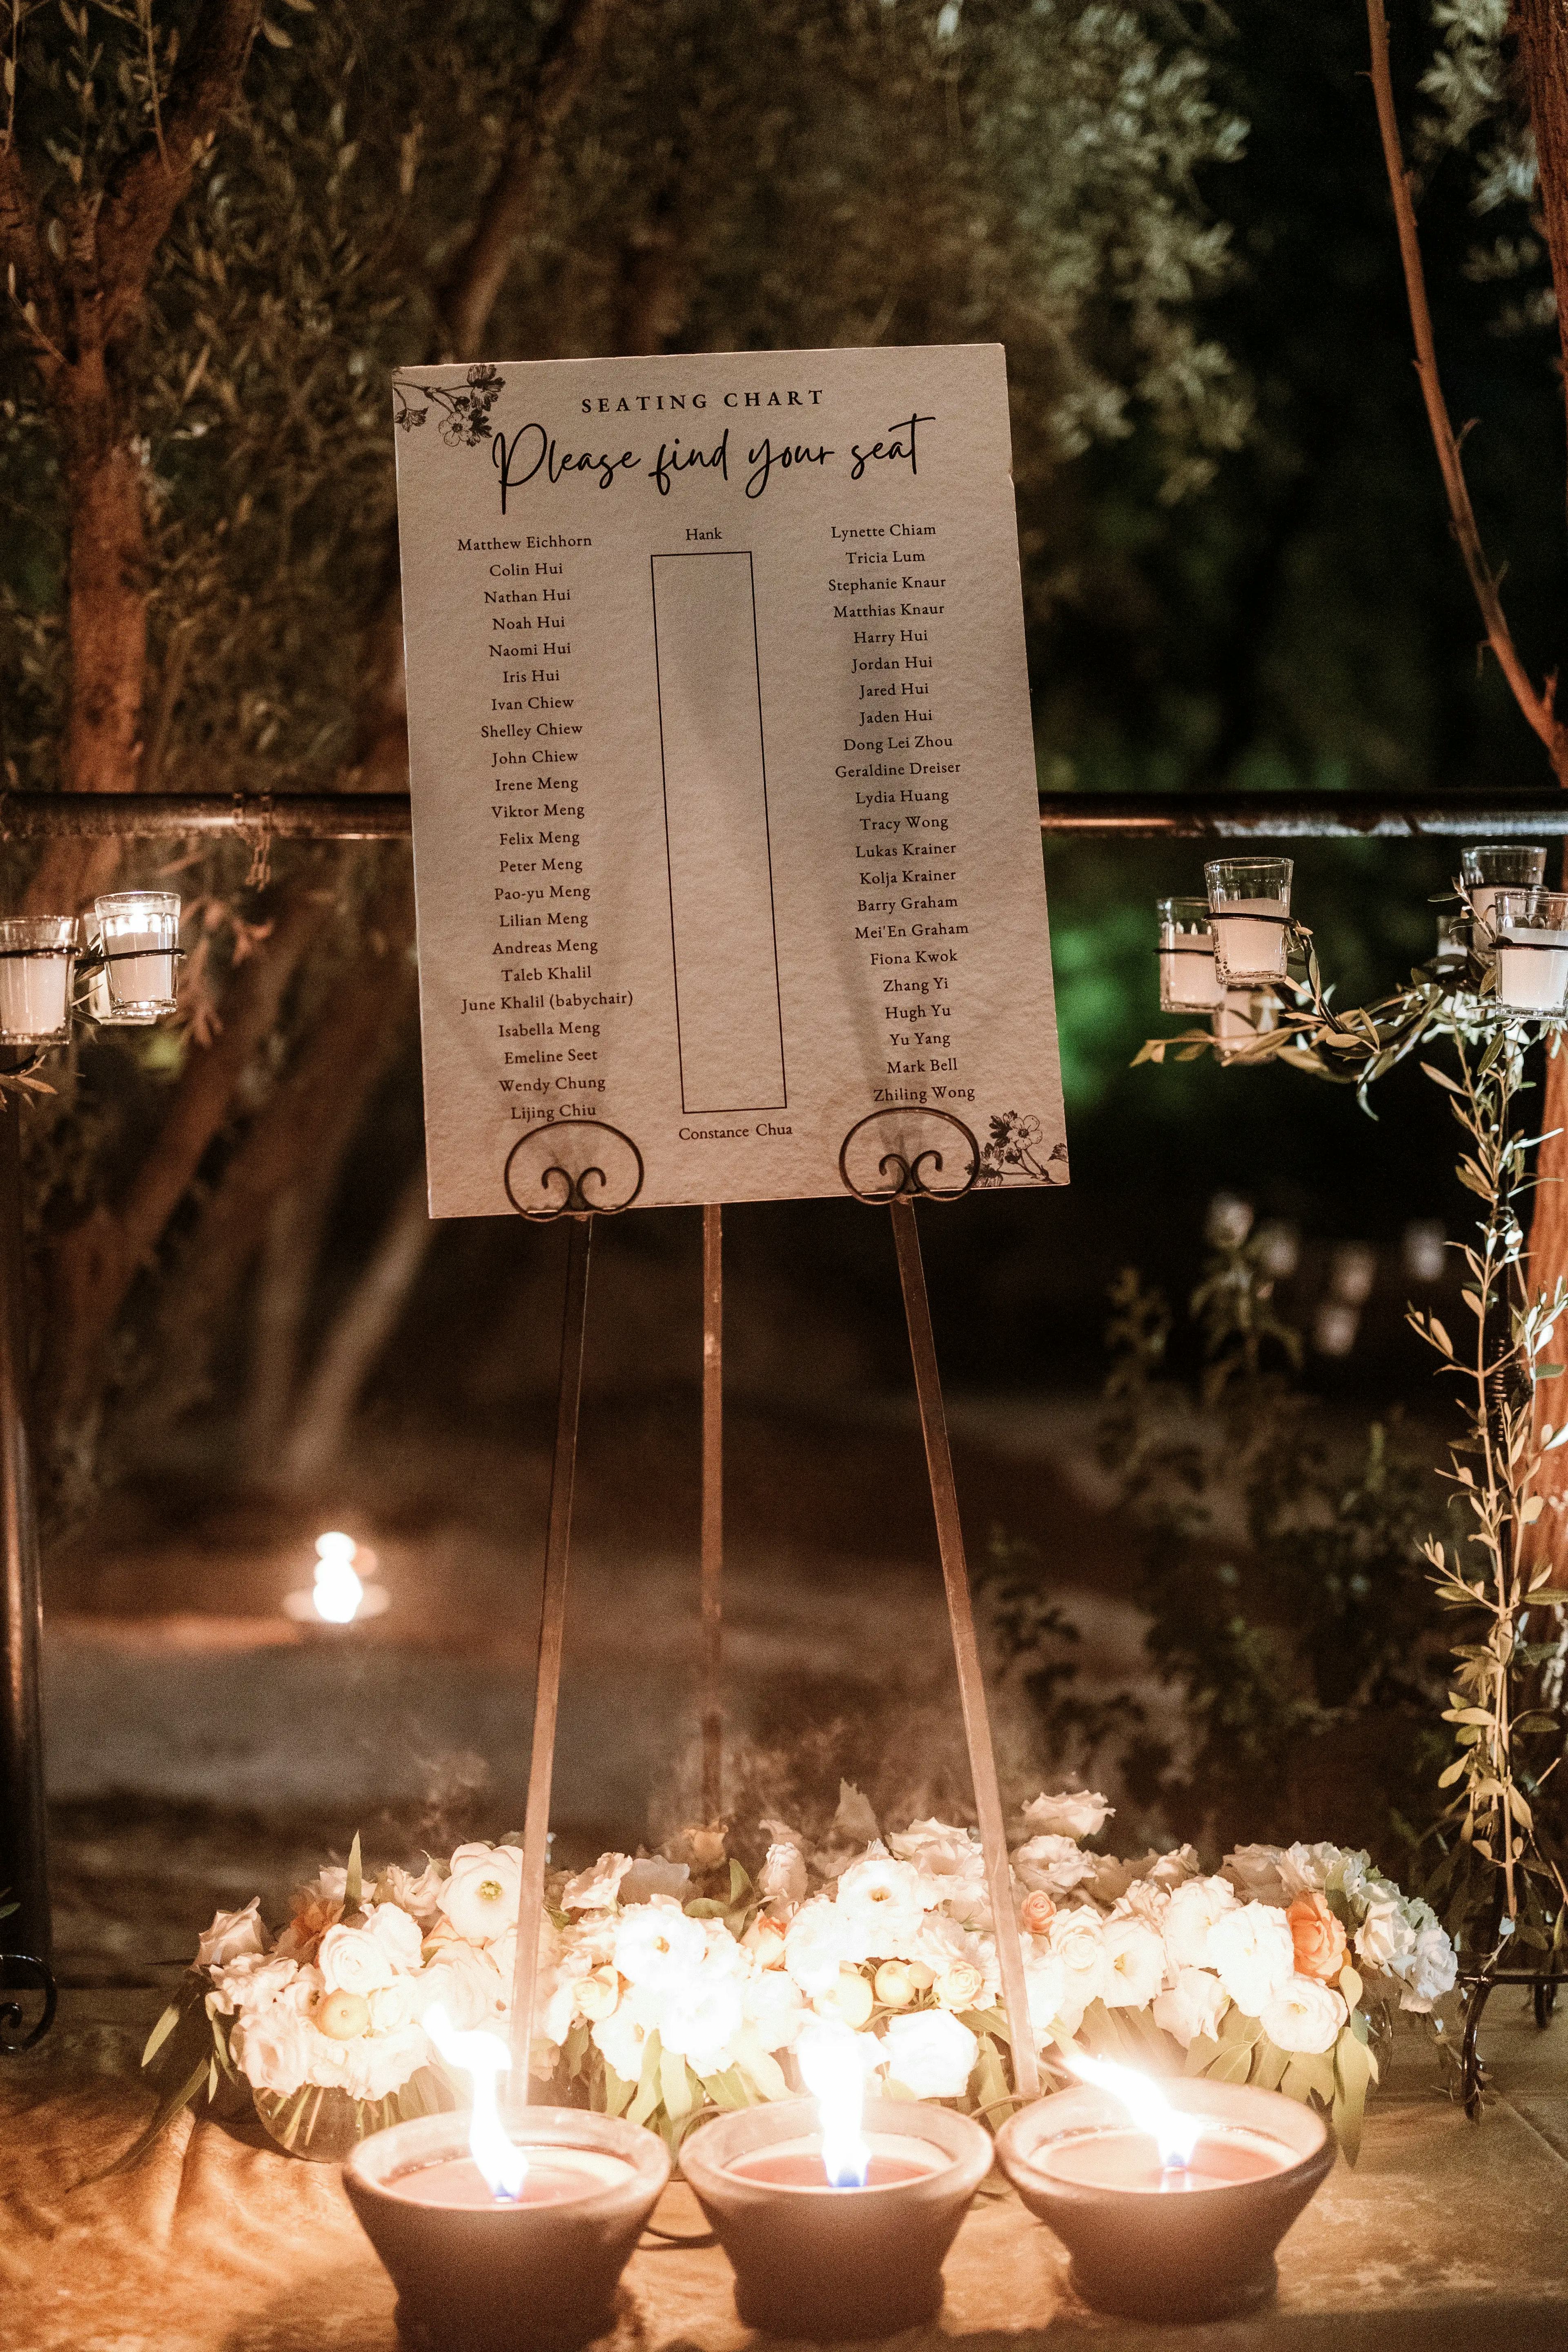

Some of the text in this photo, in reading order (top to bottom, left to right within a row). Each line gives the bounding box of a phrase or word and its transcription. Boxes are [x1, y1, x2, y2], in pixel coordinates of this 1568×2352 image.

[581, 390, 822, 413] SEATING CHART
[492, 413, 936, 515] Please find your seat
[686, 527, 722, 541] Hank
[831, 523, 936, 542] Lynette Chiam
[458, 535, 592, 551] Matthew Eichhorn
[845, 550, 925, 564] Tricia Lum
[489, 563, 563, 576] Colin Hui
[829, 576, 946, 595] Stephanie Knaur
[484, 589, 570, 604] Nathan Hui
[834, 603, 944, 618] Matthias Knaur
[492, 616, 565, 630] Noah Hui
[854, 630, 928, 646] Harry Hui
[489, 642, 570, 657] Naomi Hui
[851, 656, 932, 674] Jordan Hui
[503, 670, 559, 683] Iris Hui
[859, 683, 929, 700] Jared Hui
[492, 696, 574, 711] Ivan Chiew
[859, 710, 932, 727] Jaden Hui
[481, 722, 582, 740] Shelley Chiew
[844, 735, 953, 754] Dong Lei Zhou
[491, 750, 578, 768] John Chiew
[835, 762, 960, 778] Geraldine Dreiser
[496, 777, 578, 793] Irene Meng
[856, 790, 949, 808] Lydia Huang
[491, 804, 585, 819] Viktor Meng
[860, 816, 949, 833] Tracy Wong
[500, 831, 580, 847] Felix Meng
[855, 843, 956, 858] Lukas Krainer
[500, 858, 583, 874] Peter Meng
[860, 870, 956, 887] Kolja Krainer
[495, 885, 590, 903] Pao-yu Meng
[858, 895, 958, 915] Barry Graham
[499, 912, 588, 928] Lilian Meng
[855, 922, 969, 939] Mei'En Graham
[492, 939, 598, 955] Andreas Meng
[871, 949, 957, 965] Fiona Kwok
[501, 965, 591, 982] Taleb Khalil
[883, 977, 948, 995] Zhang Yi
[461, 991, 633, 1014] June Khalil (babychair)
[885, 1004, 951, 1022] Hugh Yu
[499, 1022, 600, 1037] Isabella Meng
[890, 1032, 950, 1048] Yu Yang
[505, 1049, 597, 1065] Emeline Seet
[887, 1058, 958, 1074] Mark Bell
[499, 1076, 606, 1095] Wendy Chung
[873, 1086, 975, 1104] Zhiling Wong
[511, 1103, 596, 1123] Lijing Chiu
[679, 1123, 793, 1140] Constance Chua
